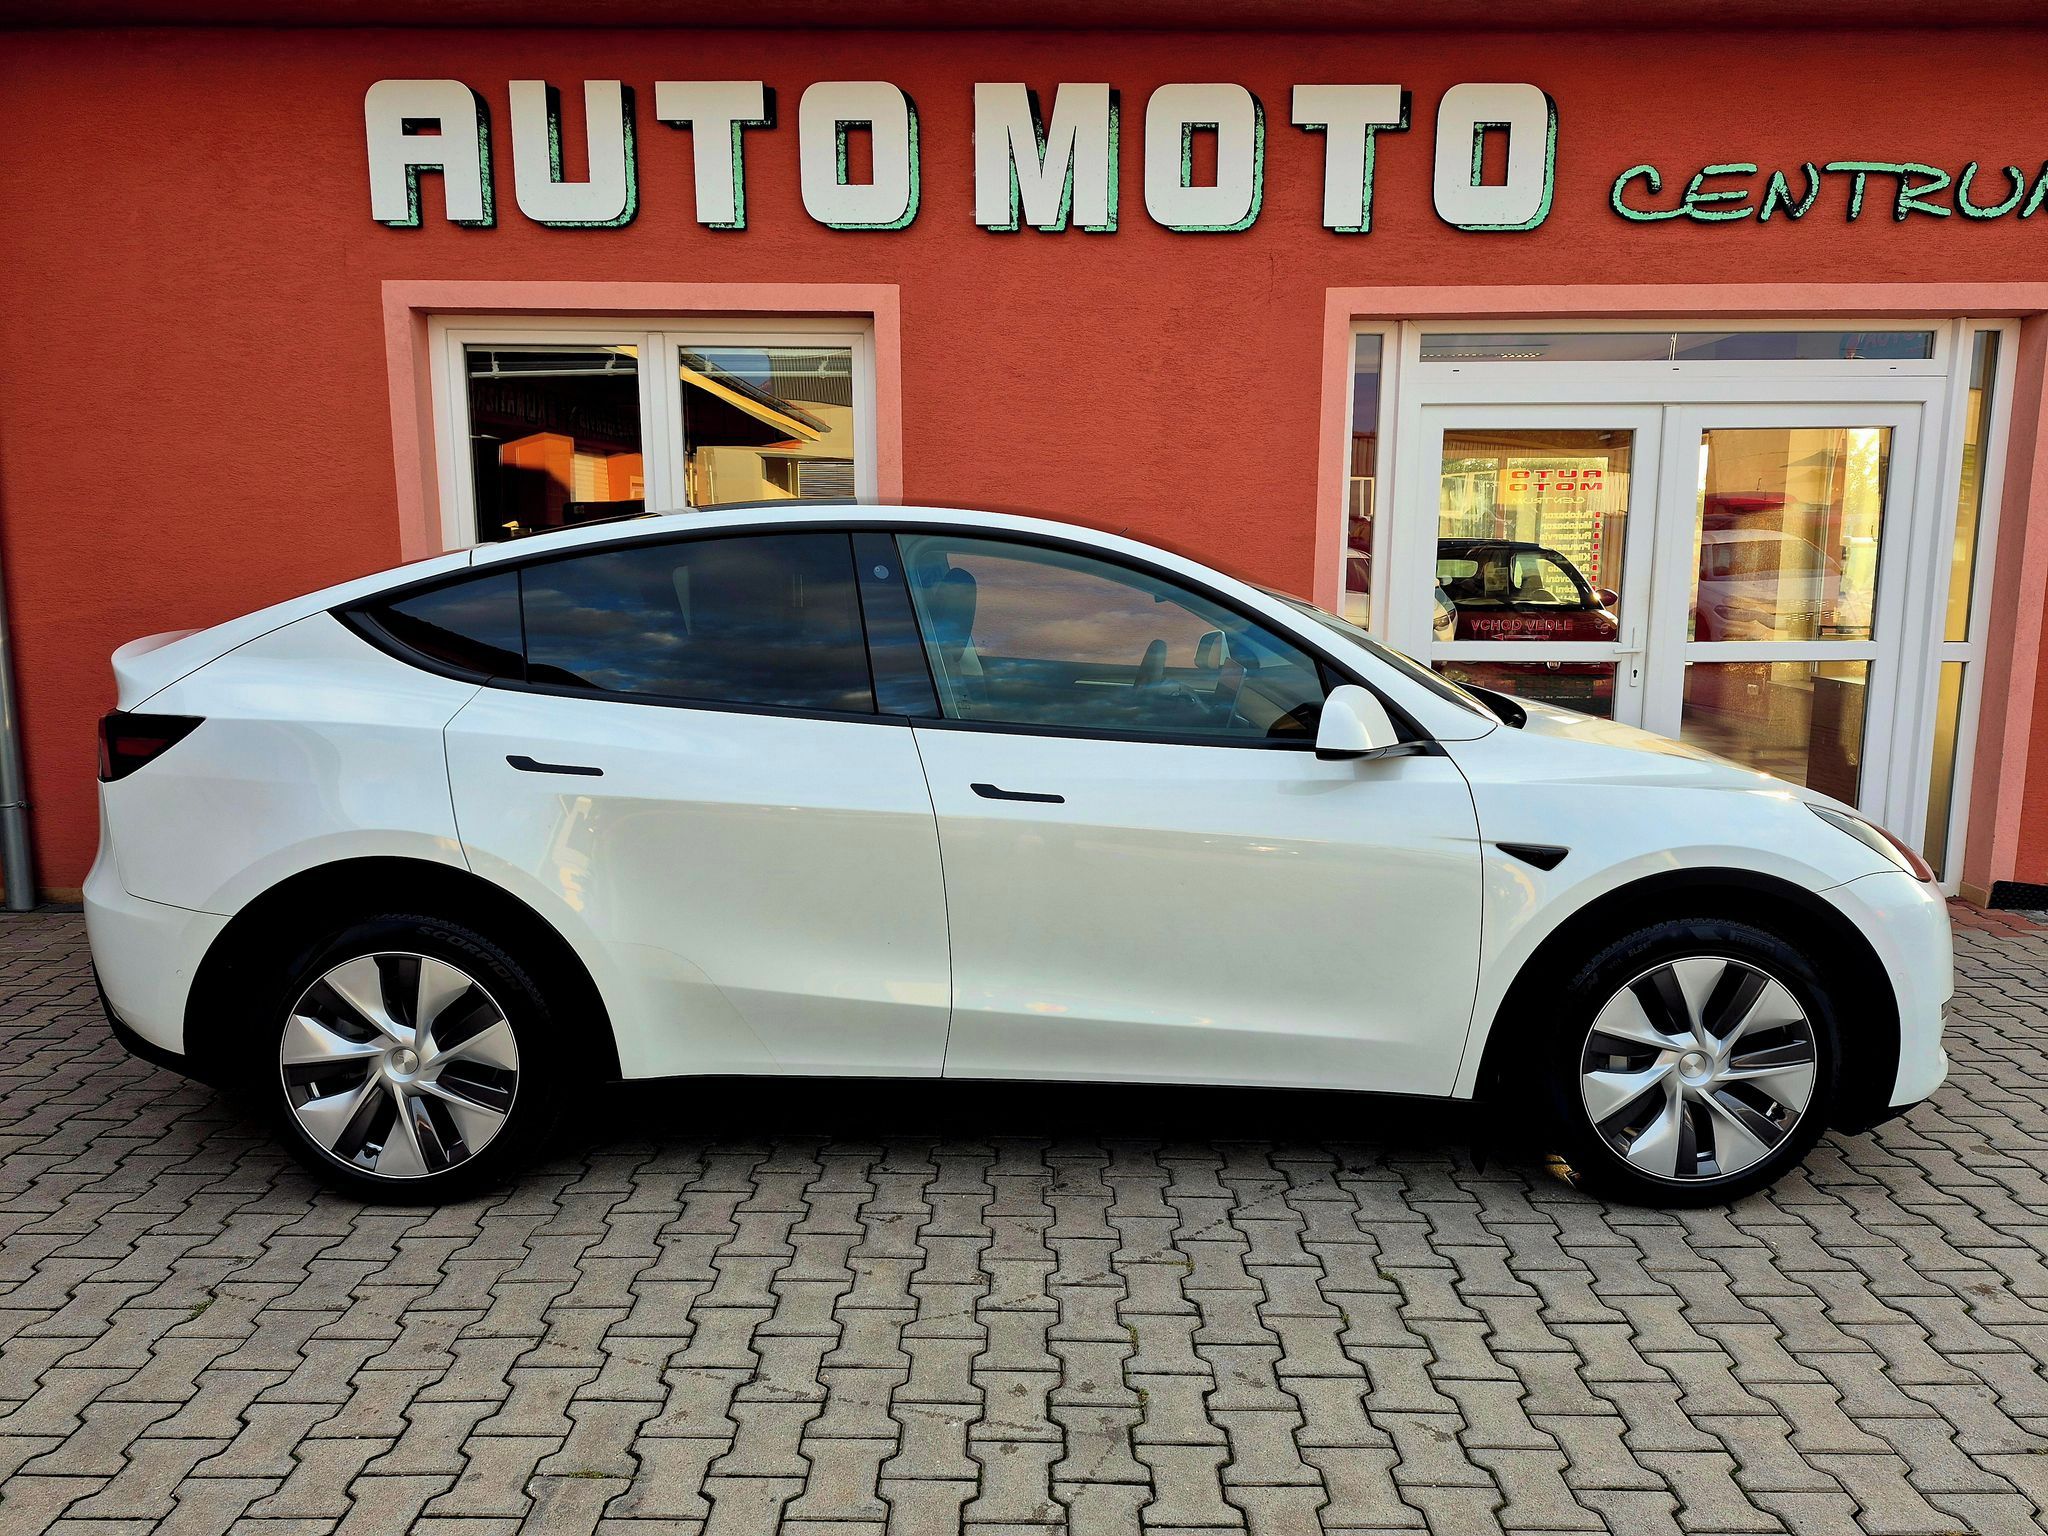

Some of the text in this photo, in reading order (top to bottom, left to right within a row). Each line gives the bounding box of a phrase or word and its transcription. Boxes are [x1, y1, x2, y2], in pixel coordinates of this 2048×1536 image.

[364, 78, 922, 231] AUTO
[972, 81, 1559, 234] MOTO
[1471, 619, 1573, 631] VCHOD VEDLE
